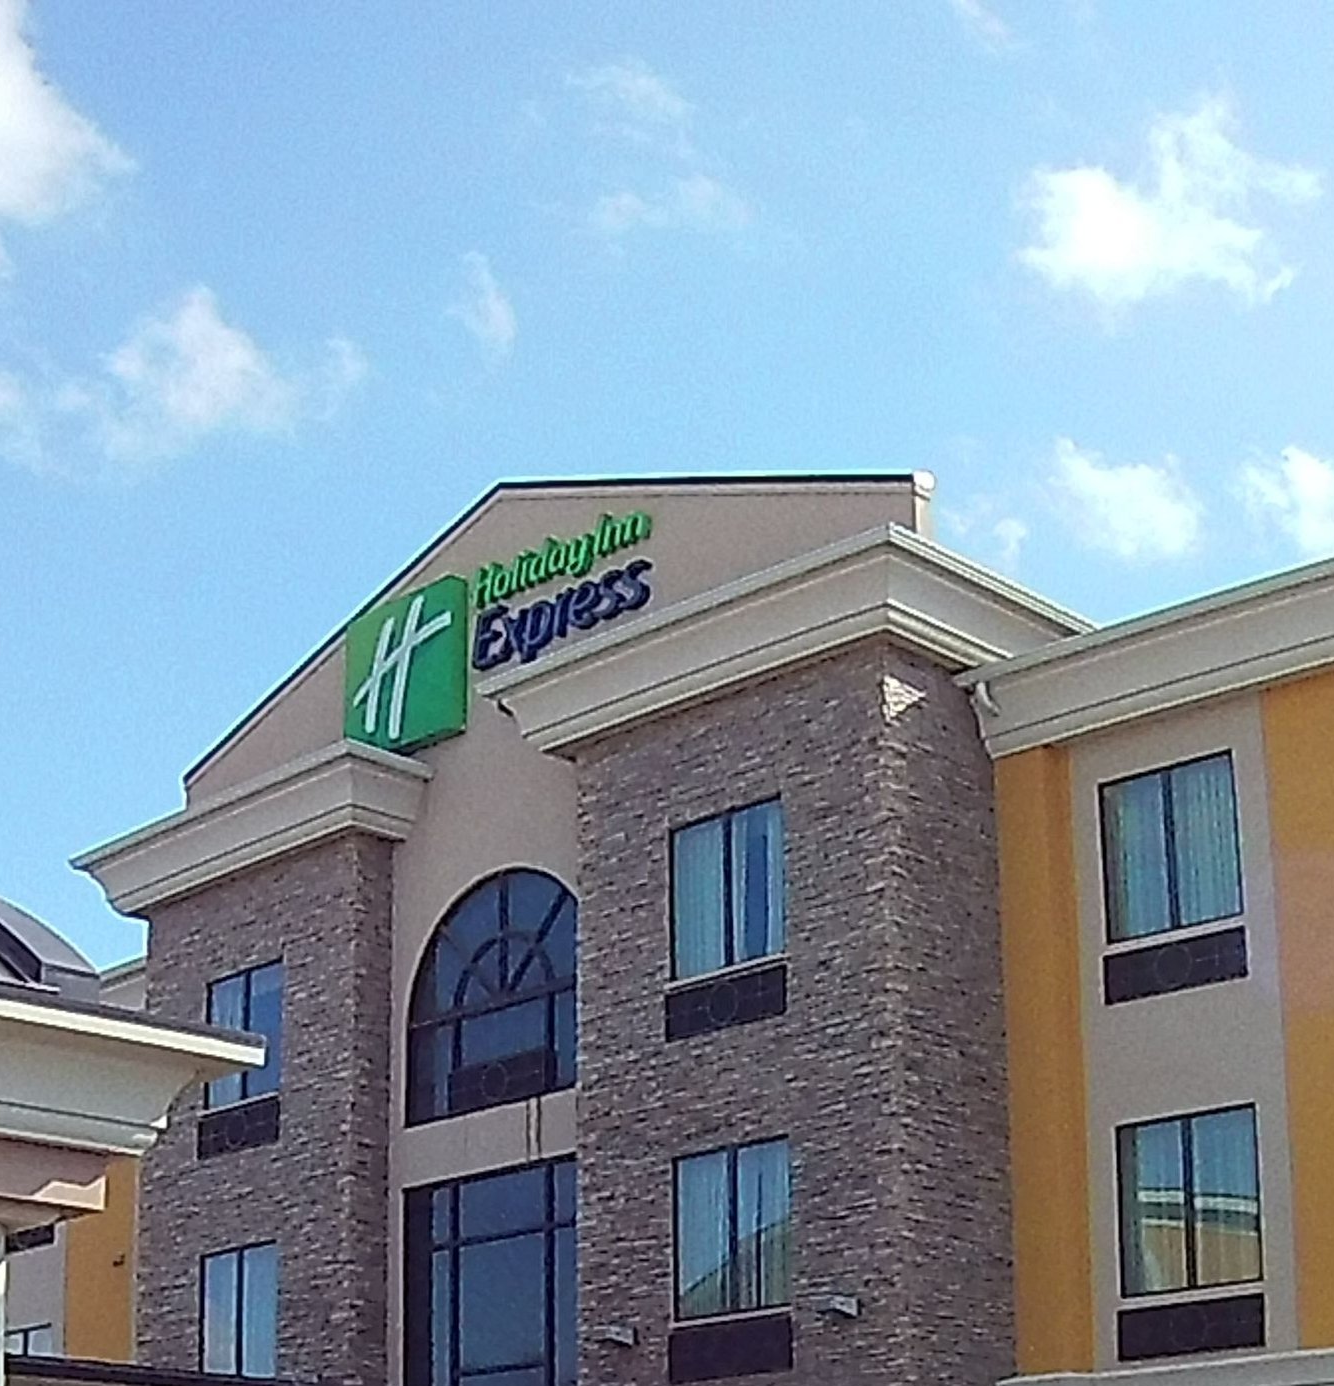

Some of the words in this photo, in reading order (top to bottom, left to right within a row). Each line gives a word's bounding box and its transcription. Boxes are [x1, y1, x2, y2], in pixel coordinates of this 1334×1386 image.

[471, 534, 597, 609] Holiday
[593, 510, 653, 558] Inn
[472, 558, 654, 670] Express
